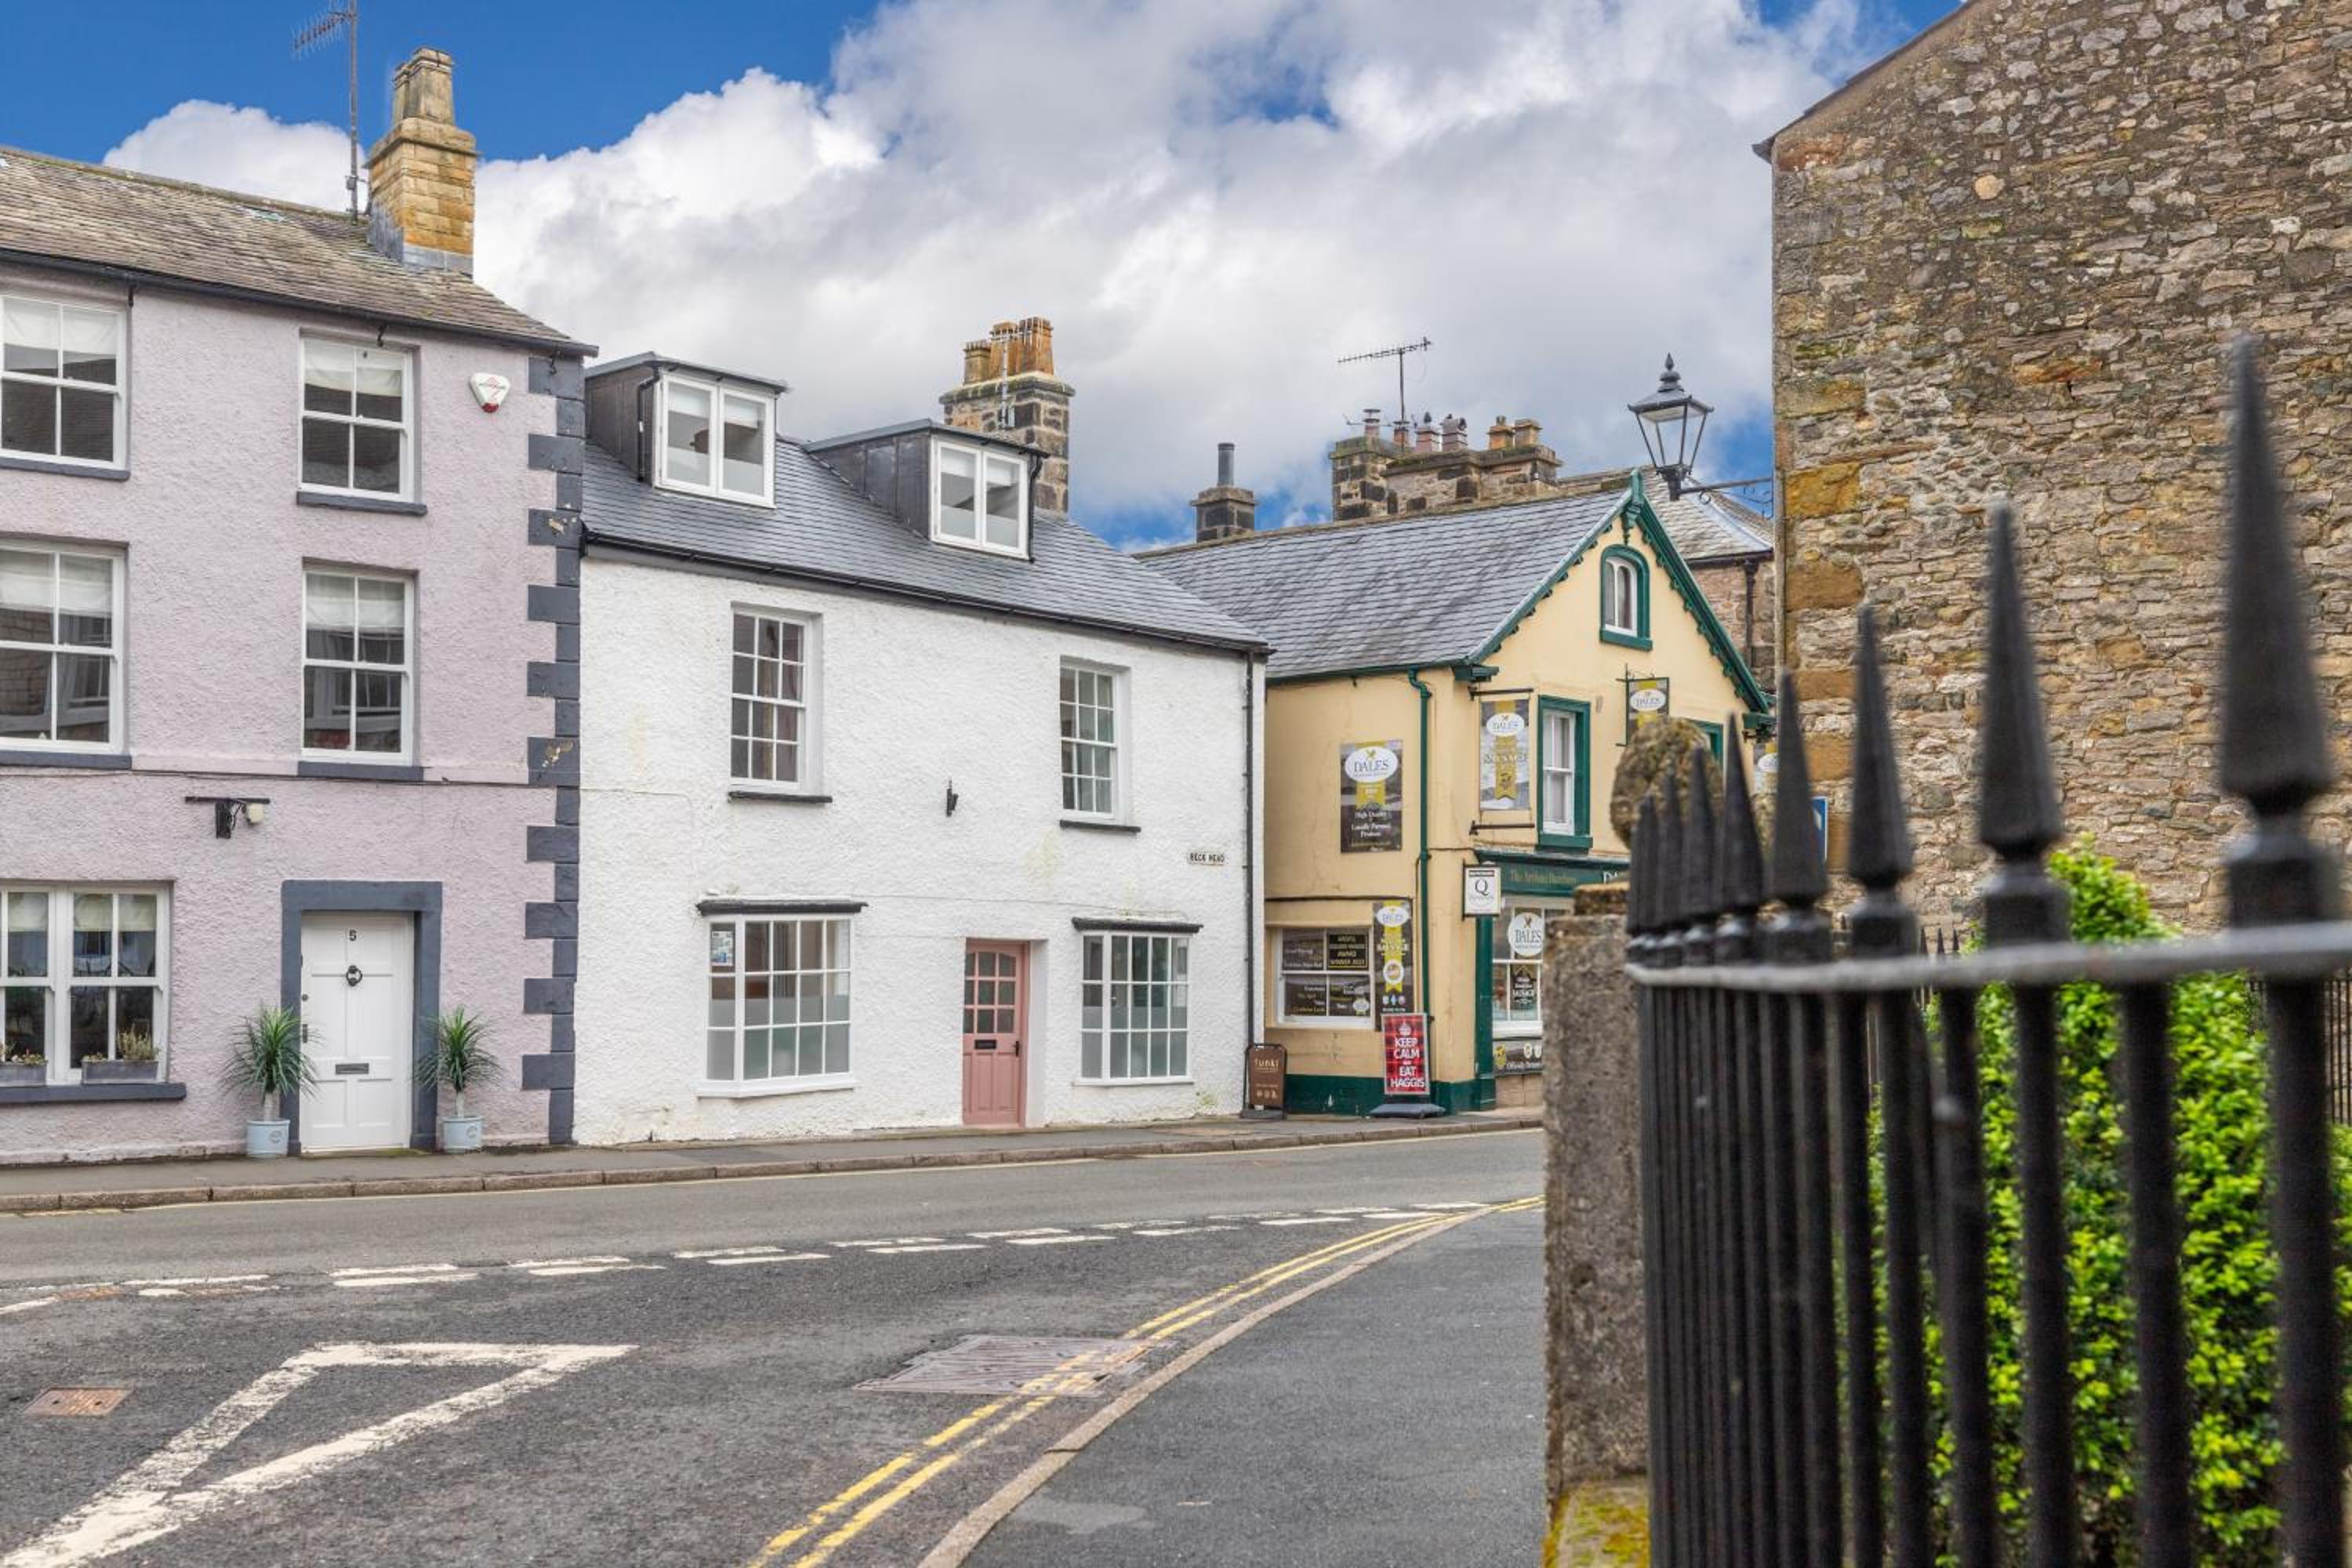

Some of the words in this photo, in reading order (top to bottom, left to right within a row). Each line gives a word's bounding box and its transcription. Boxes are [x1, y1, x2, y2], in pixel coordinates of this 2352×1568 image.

[1354, 759, 1389, 772] DALES
[1475, 878, 1489, 896] Q
[349, 929, 357, 941] 5
[1515, 929, 1542, 943] DALES
[1395, 1036, 1418, 1047] KEEP
[1393, 1048, 1420, 1059] CALM
[1399, 1065, 1417, 1076] EAT
[1390, 1078, 1425, 1088] HAGGIS
